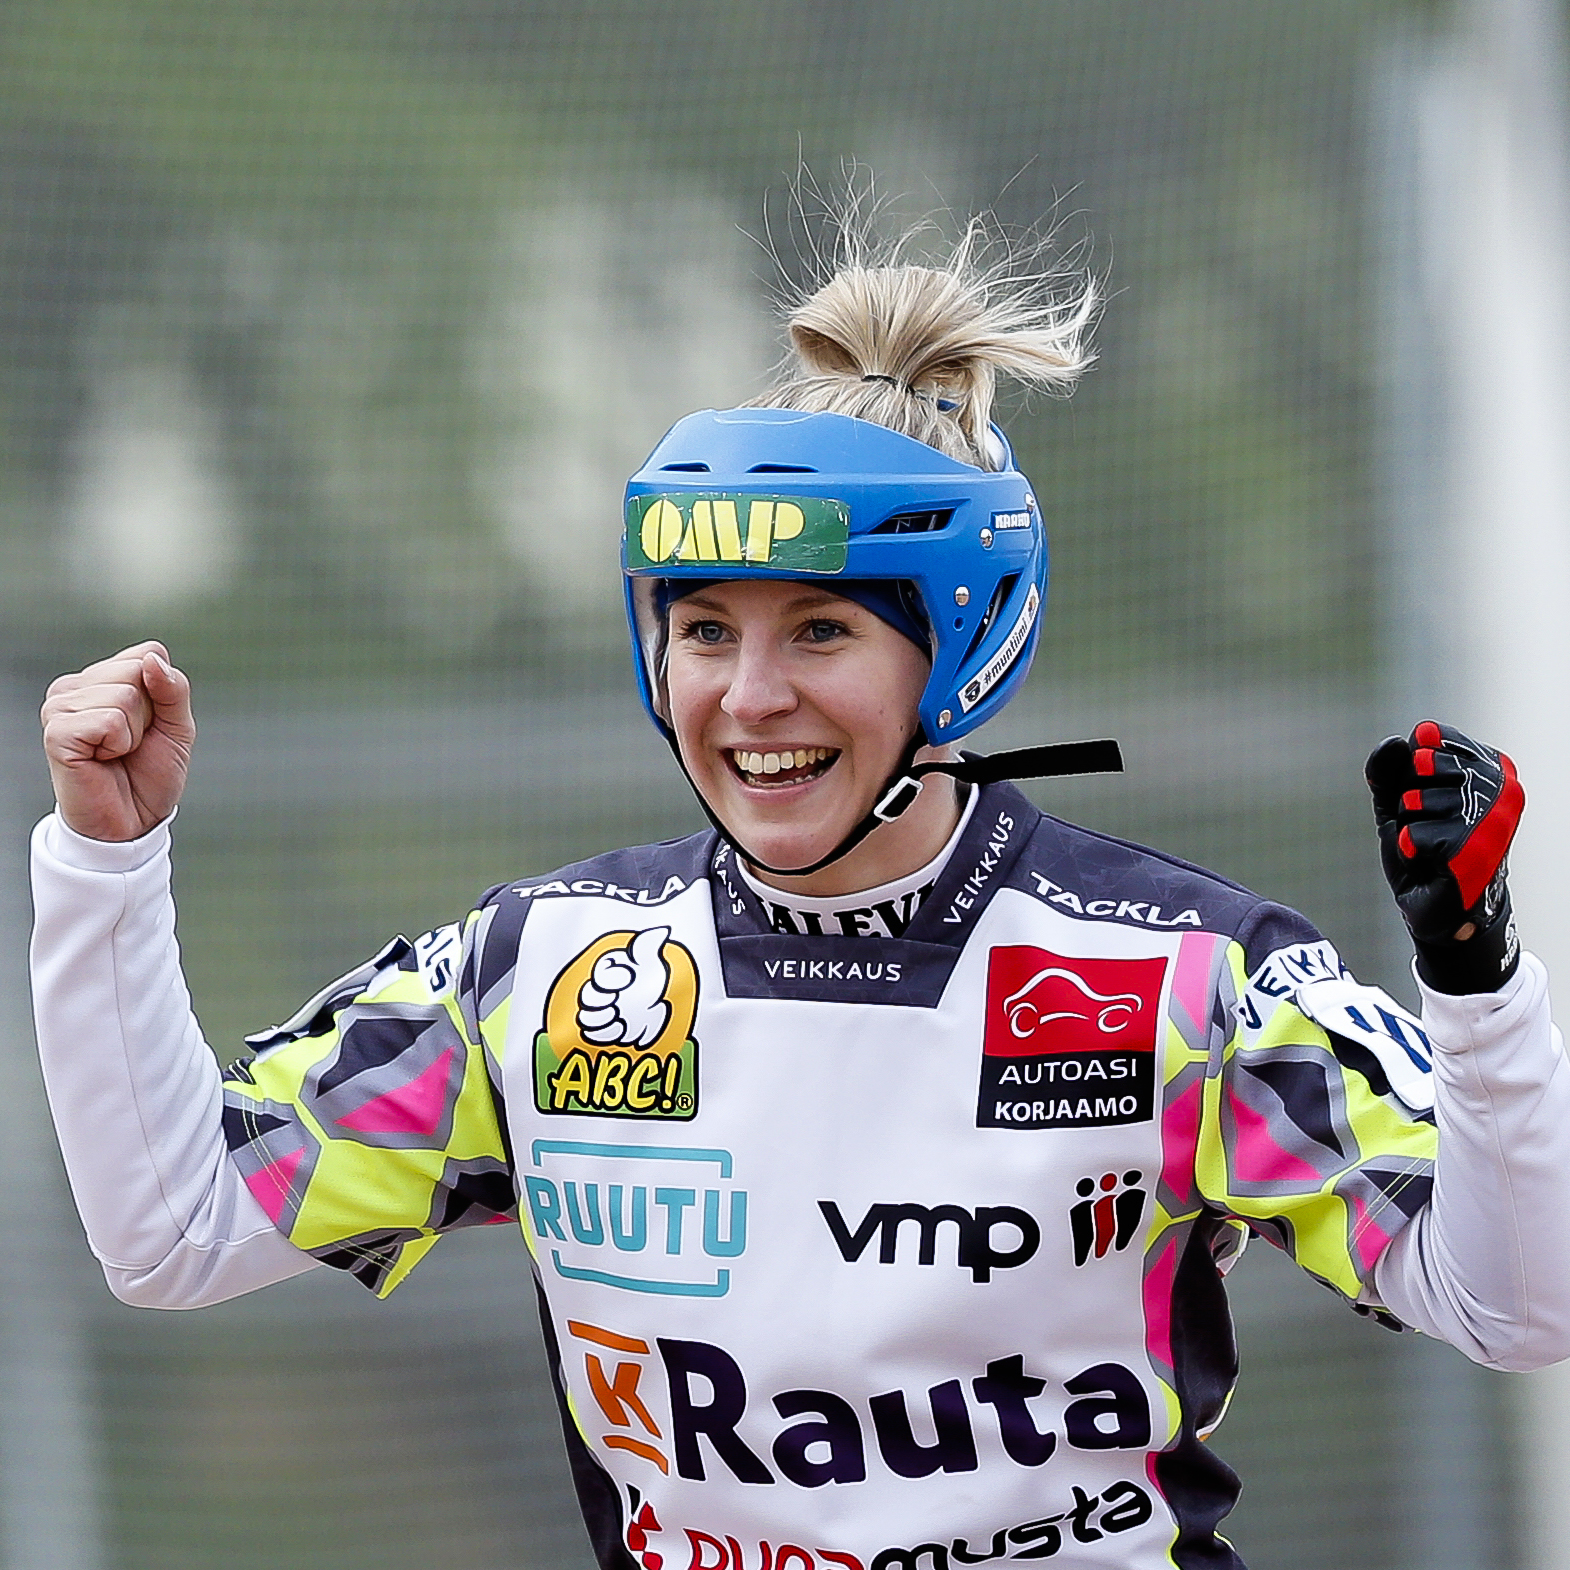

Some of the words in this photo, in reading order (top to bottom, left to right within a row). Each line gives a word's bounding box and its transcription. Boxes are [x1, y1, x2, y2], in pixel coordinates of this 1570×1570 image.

[641, 499, 806, 563] OMP
[512, 875, 686, 904] TACKLA
[943, 811, 1015, 926] VEIKKAUS
[1030, 870, 1203, 927] TACKLA
[764, 959, 902, 982] VEIKKAUS
[548, 1051, 680, 1112] ABC!
[999, 1058, 1137, 1085] AUTOASI
[994, 1096, 1138, 1122] KORJAAMO
[525, 1176, 749, 1257] RUUTU
[817, 1200, 1040, 1283] vmp
[656, 1337, 1151, 1488] Rauta
